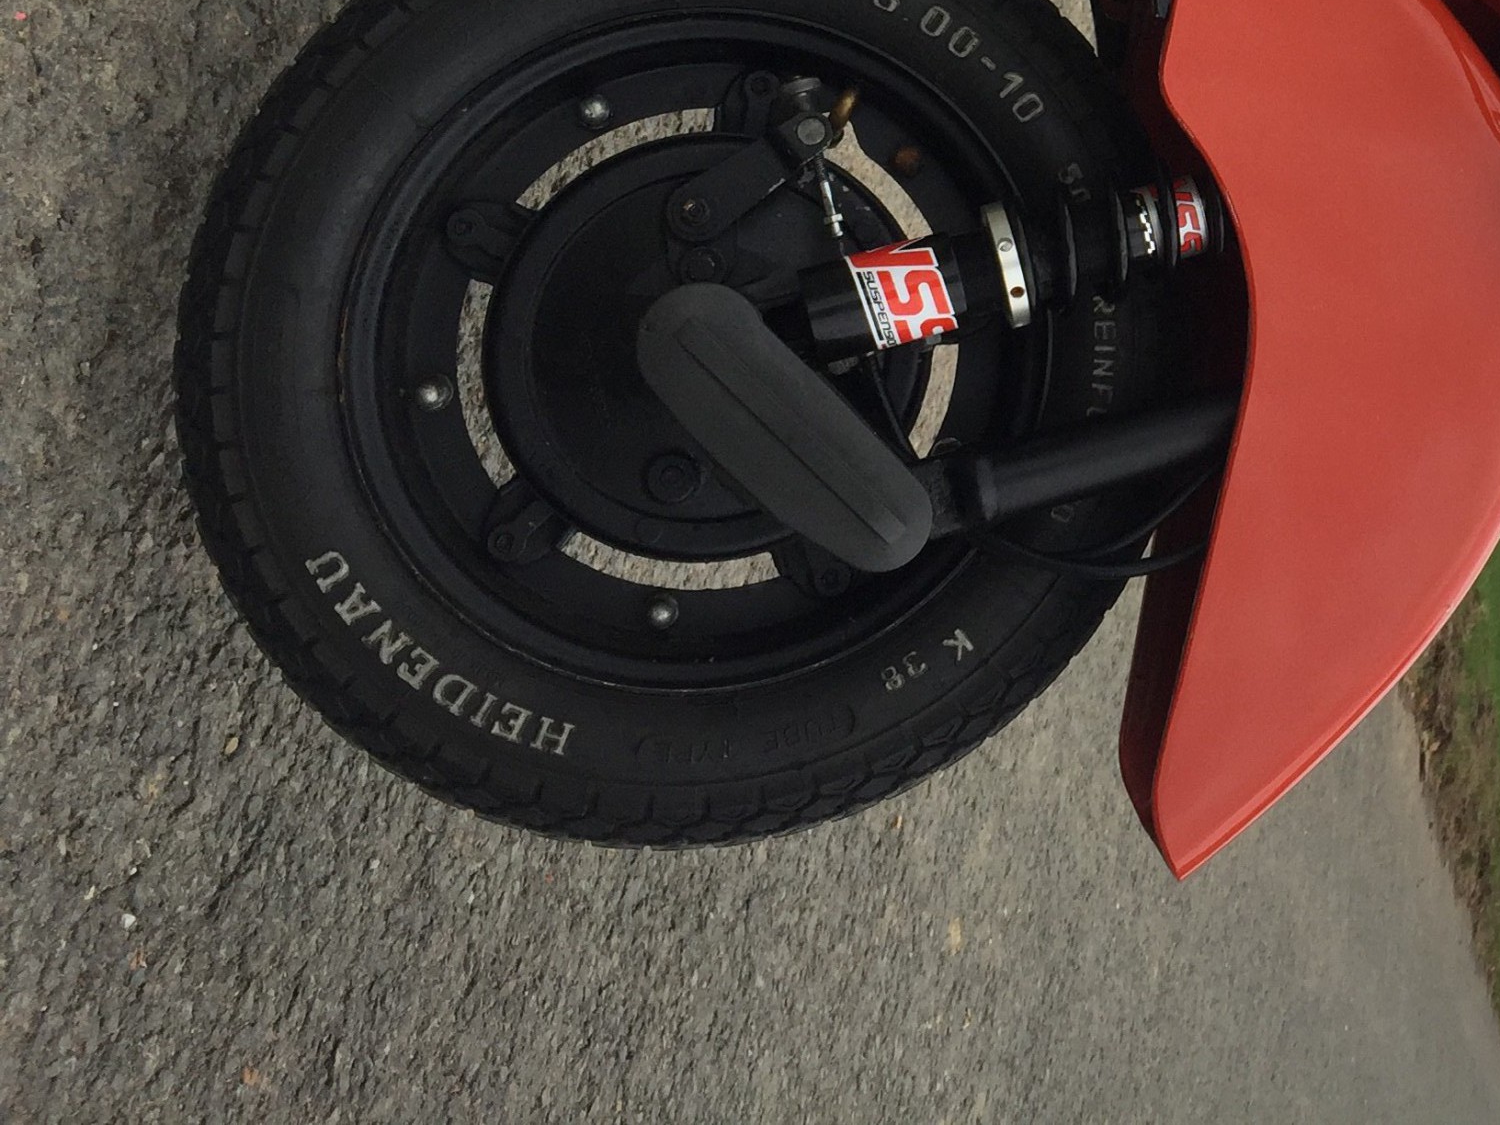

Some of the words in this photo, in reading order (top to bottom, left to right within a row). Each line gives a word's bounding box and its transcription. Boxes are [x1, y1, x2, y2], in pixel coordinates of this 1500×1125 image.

[304, 550, 576, 756] HEIDENAU
[941, 628, 975, 662] K
[880, 651, 927, 691] 38
